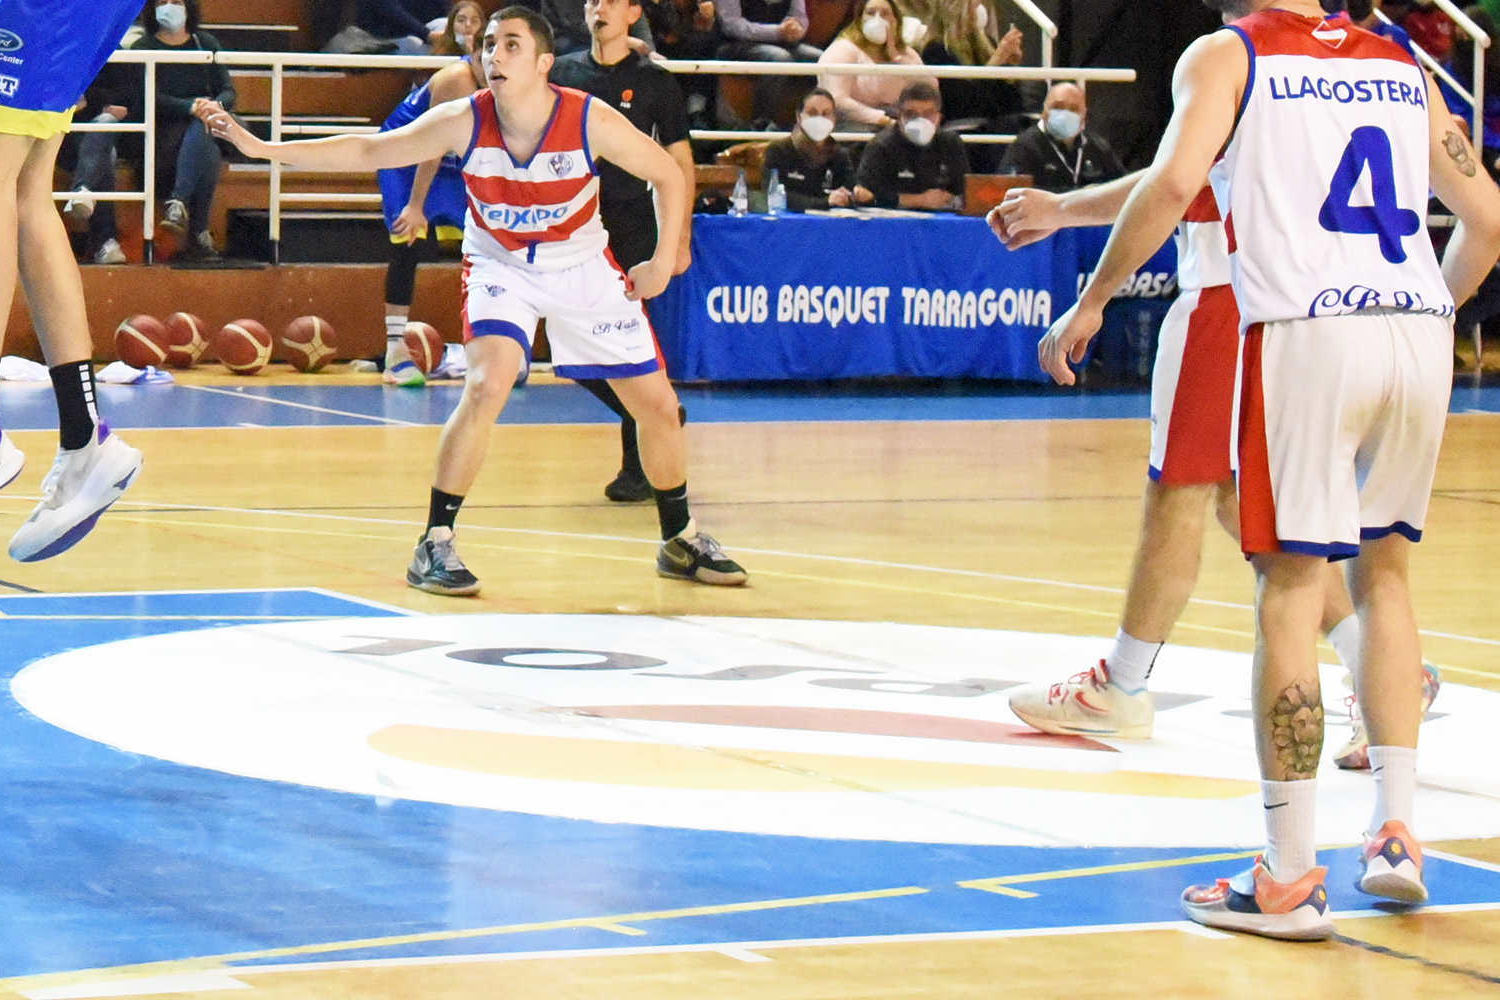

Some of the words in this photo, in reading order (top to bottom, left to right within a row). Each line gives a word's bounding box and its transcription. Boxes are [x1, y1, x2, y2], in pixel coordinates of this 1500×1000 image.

[1269, 75, 1426, 111] LLAGOSTERA
[1318, 125, 1421, 264] 4
[706, 285, 769, 324] CLUB
[776, 284, 890, 329] BASQUET
[902, 286, 1052, 329] TARRAGONA
